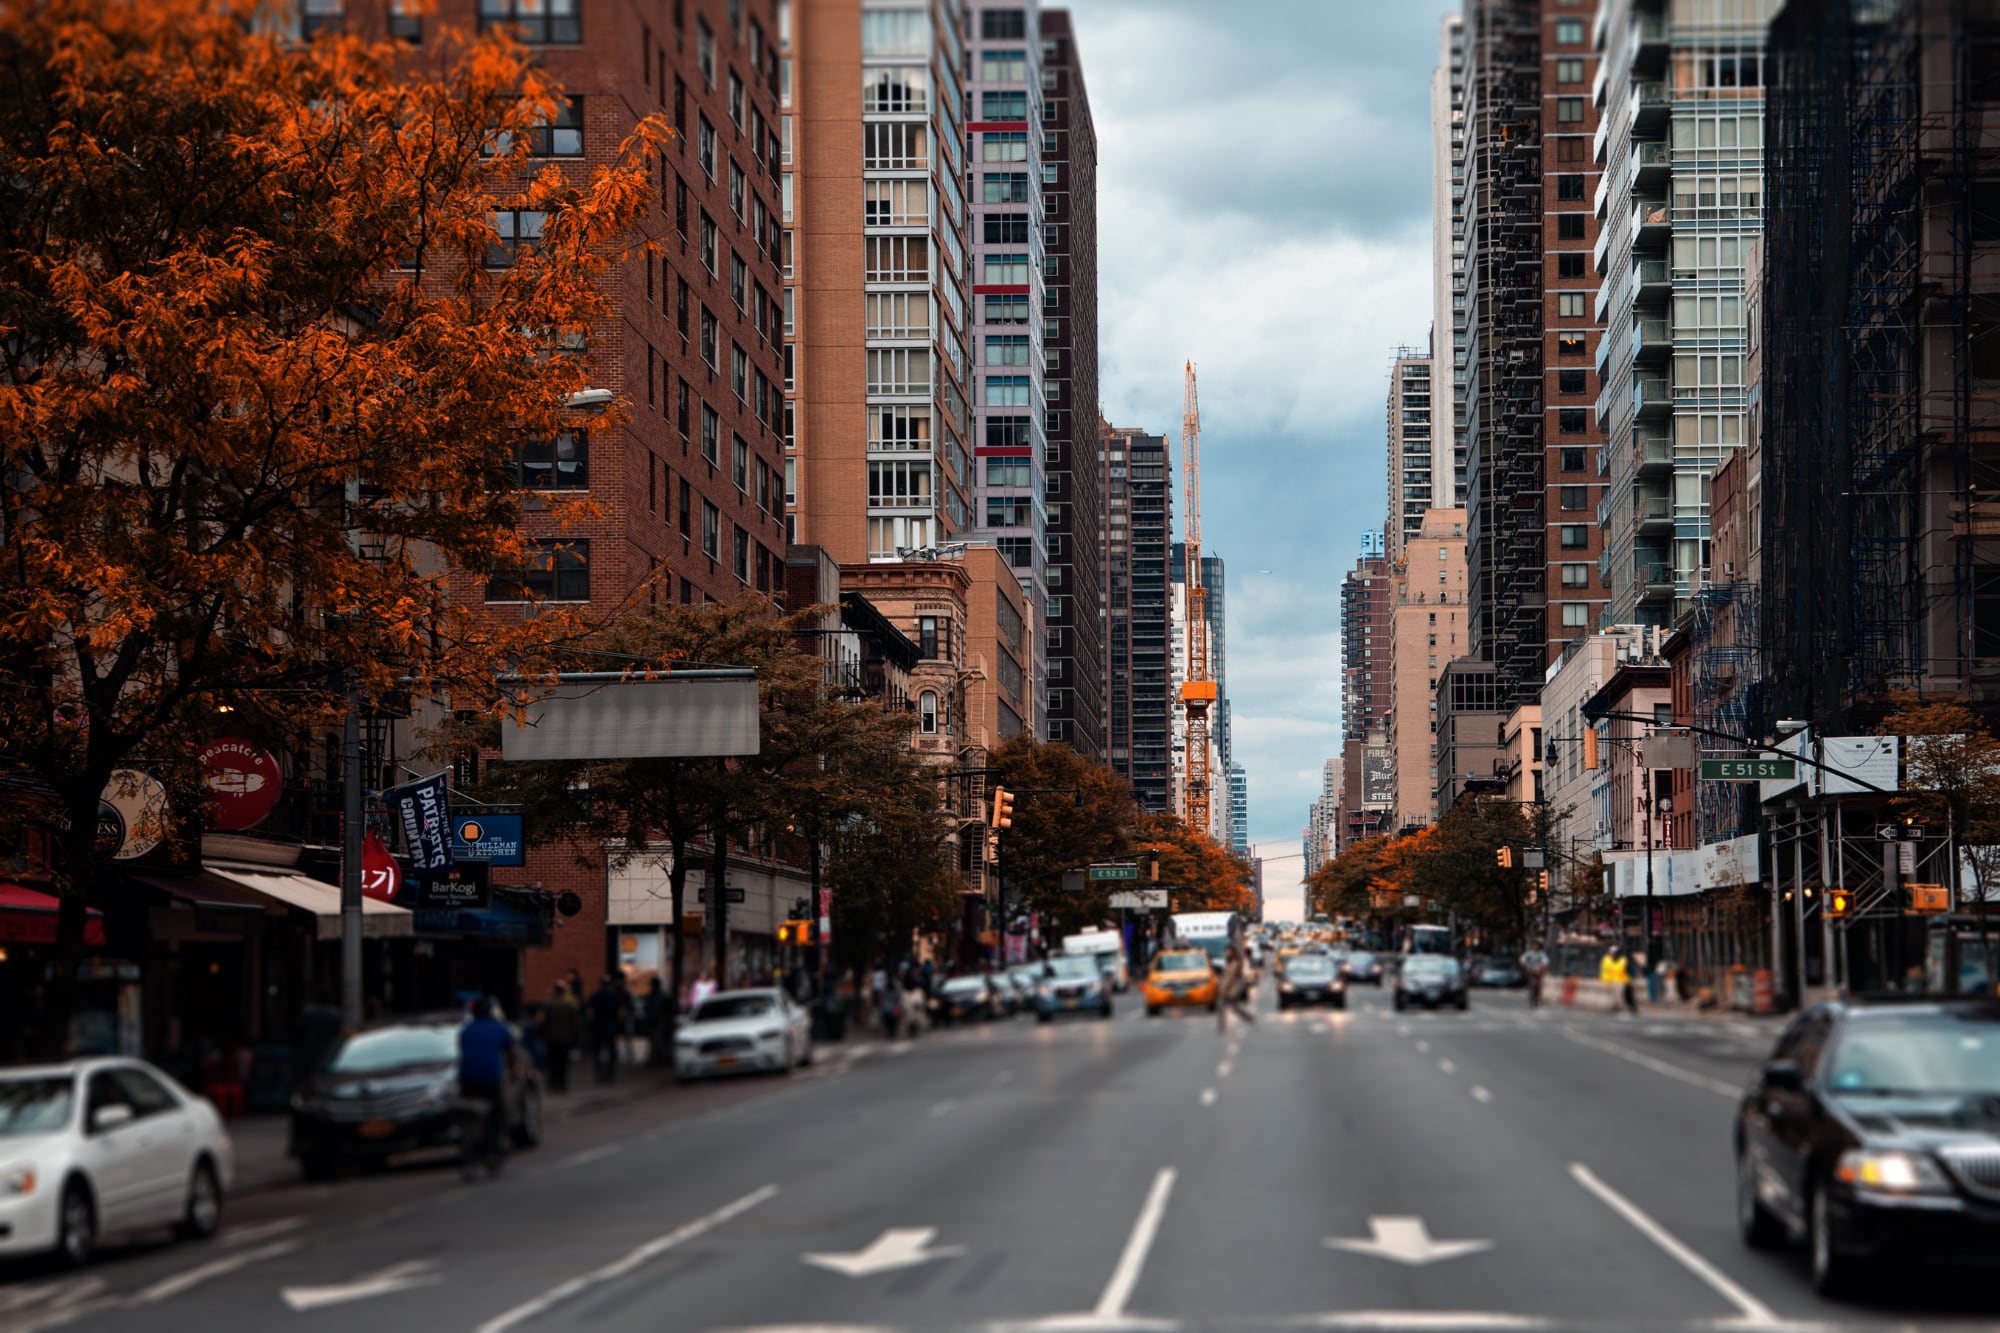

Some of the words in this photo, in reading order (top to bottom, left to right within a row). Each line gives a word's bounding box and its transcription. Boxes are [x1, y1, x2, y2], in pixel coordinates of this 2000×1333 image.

[1721, 764, 1730, 775] E
[1736, 764, 1752, 775] 51
[1758, 764, 1776, 776] St
[401, 797, 427, 869] COUNTRY
[416, 786, 447, 869] PATRIOTS
[476, 848, 516, 856] KITCHEN
[1098, 870, 1104, 878] E
[1105, 870, 1117, 878] 52
[1119, 870, 1128, 878] St
[432, 881, 476, 896] BarKogi
